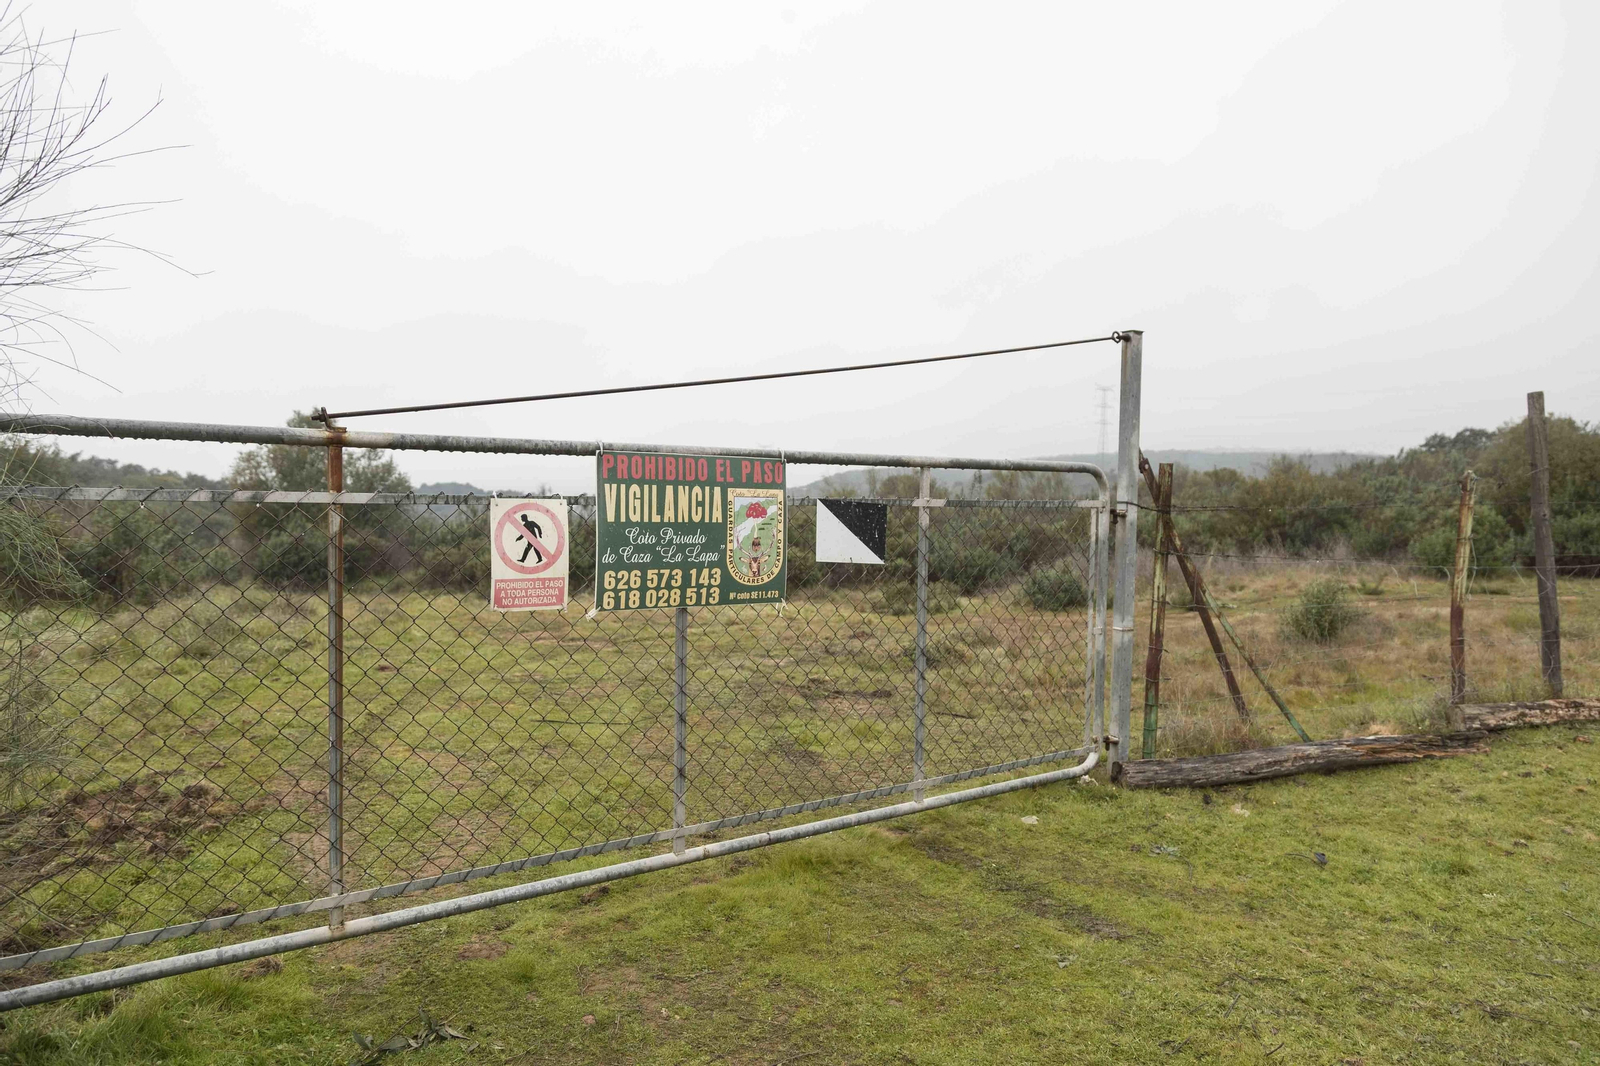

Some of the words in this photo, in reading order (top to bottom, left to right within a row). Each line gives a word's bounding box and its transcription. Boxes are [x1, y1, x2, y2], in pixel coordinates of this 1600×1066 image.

[602, 454, 708, 481] PROHIBIDO
[716, 459, 734, 482] EL
[741, 460, 783, 484] PASO
[604, 483, 723, 523] VIGILANCIA
[625, 527, 657, 545] Coto
[660, 527, 707, 545] Privado
[602, 547, 617, 564] de
[619, 546, 653, 563] Caza
[728, 549, 765, 584] PARTICULARES
[767, 570, 775, 580] DE
[774, 539, 782, 569] CAMPO
[496, 582, 534, 590] PROHIBIDO
[604, 570, 642, 590] 626
[647, 569, 683, 588] 573
[689, 568, 722, 586] 143
[514, 596, 557, 605] AUTORIZADA
[527, 588, 559, 596] PERSONA
[603, 589, 641, 610] 618
[645, 588, 681, 608] 028
[686, 587, 720, 606] 513
[737, 592, 751, 600] coto
